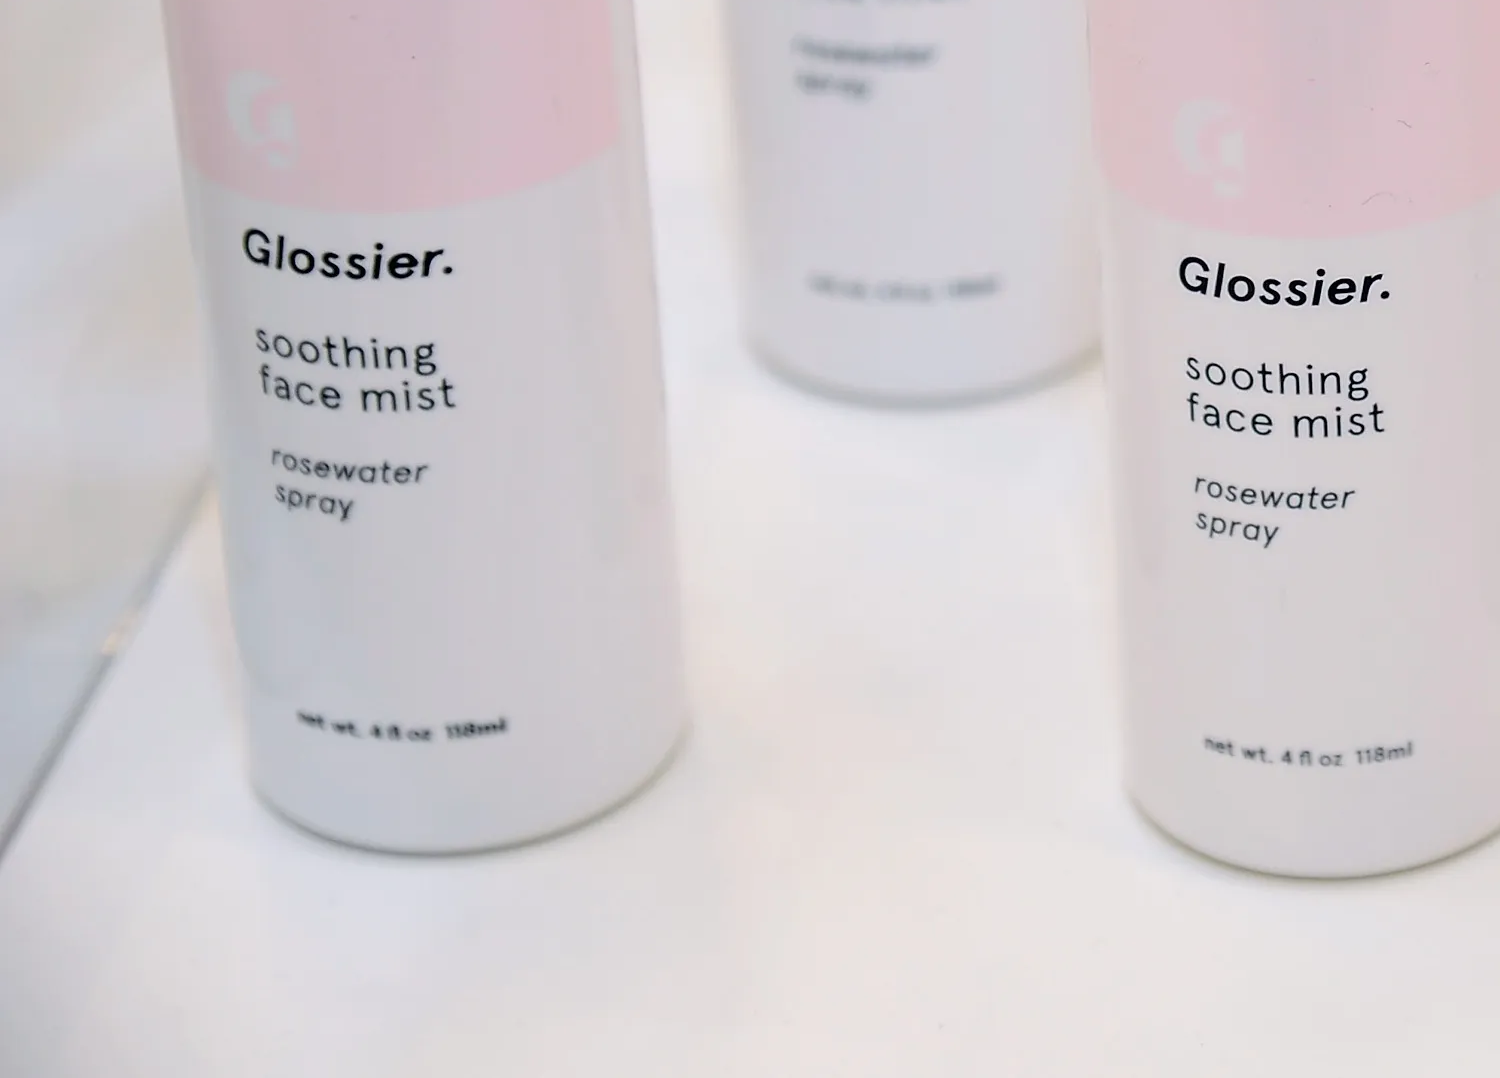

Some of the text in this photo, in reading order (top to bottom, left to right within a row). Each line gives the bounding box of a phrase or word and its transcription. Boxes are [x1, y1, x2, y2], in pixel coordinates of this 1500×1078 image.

[242, 227, 454, 281] Glossier.
[1178, 256, 1391, 307] Glossier.
[255, 327, 438, 377] soothing
[259, 363, 457, 412] face mist
[1186, 355, 1370, 402] soothing
[1186, 392, 1386, 439] face mist
[271, 448, 430, 486] rosewater
[274, 484, 355, 522] spray
[1194, 475, 1357, 511] rosewater
[1195, 511, 1280, 550] spray
[1204, 737, 1414, 767] net wt. 4 fl oz 118ml
